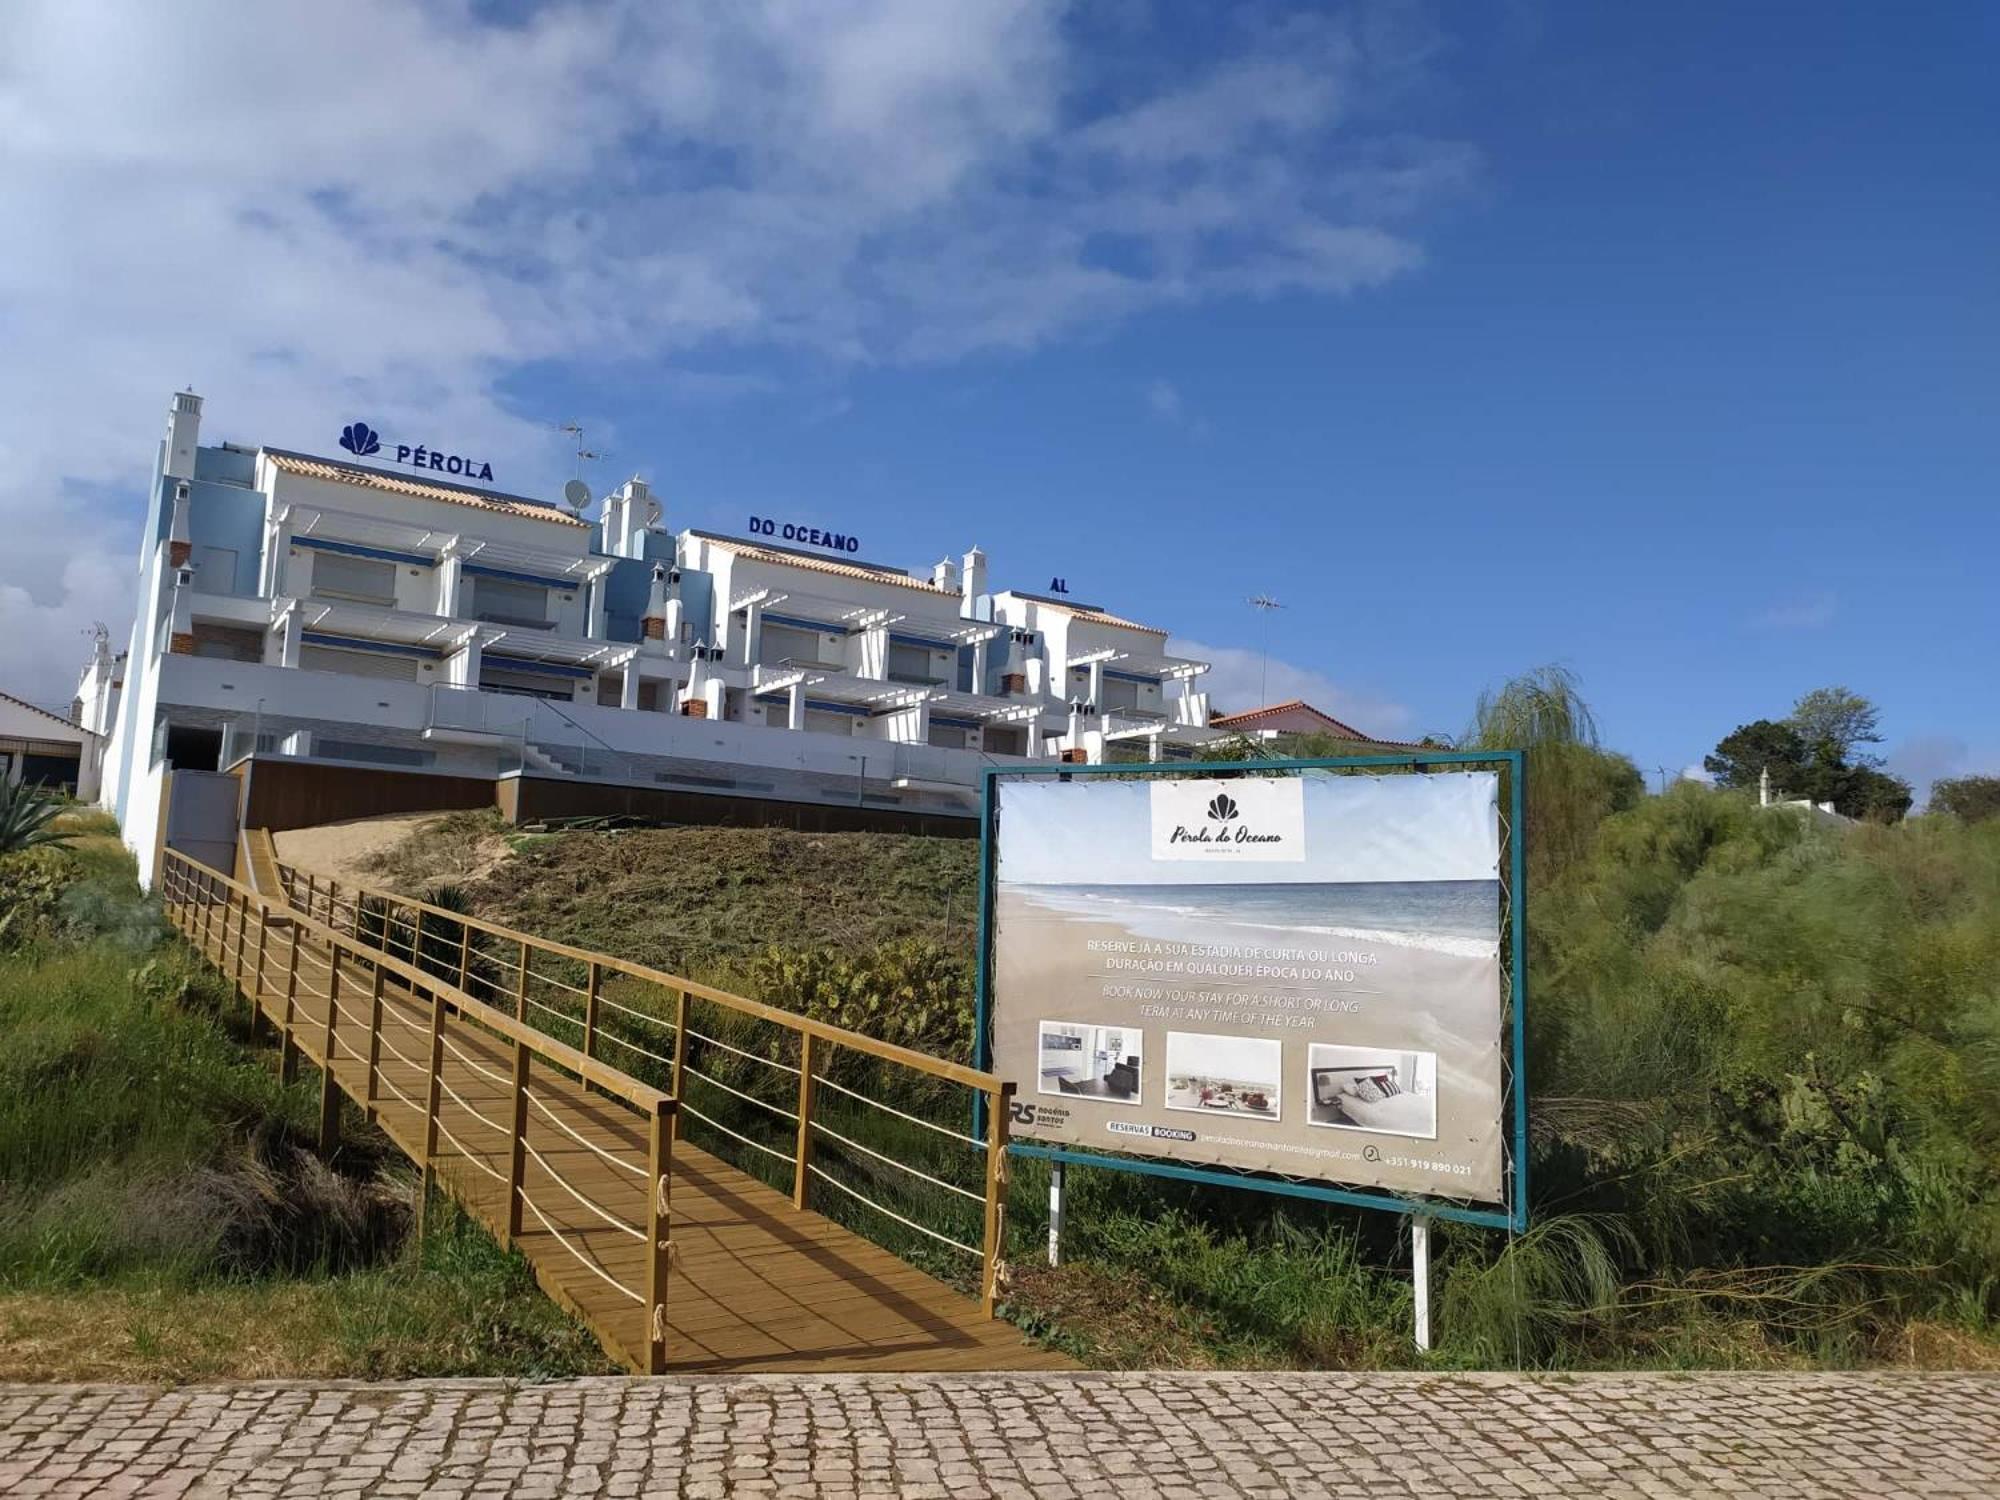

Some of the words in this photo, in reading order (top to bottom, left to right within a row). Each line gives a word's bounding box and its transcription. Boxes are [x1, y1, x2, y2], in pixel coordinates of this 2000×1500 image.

[396, 445, 493, 481] PÉROLA
[749, 516, 775, 535] DO
[783, 524, 859, 552] OCEANO
[1049, 577, 1069, 593] AL
[1170, 825, 1212, 844] Pérola
[1215, 826, 1231, 843] do
[1235, 825, 1282, 844] Oceano
[1087, 940, 1138, 953] RESERVE
[1138, 940, 1151, 954] JÁ
[1153, 943, 1162, 954] A
[1165, 943, 1187, 956] SUA
[1191, 945, 1241, 958] ESTADIA
[1244, 947, 1261, 959] DE
[1263, 948, 1305, 961] CURTA
[1308, 950, 1328, 962] OU
[1331, 951, 1377, 965] LONGA
[1106, 958, 1163, 972] DURAÇÃO
[1166, 961, 1184, 973] EM
[1186, 962, 1253, 977] QUALQUER
[1302, 968, 1321, 980] DO
[1324, 968, 1355, 982] ANO
[1103, 984, 1134, 999] BOOK
[1134, 987, 1165, 1000] NOW
[1166, 989, 1196, 1002] YOUR
[1199, 991, 1223, 1004] STAY
[1226, 993, 1249, 1006] FOR
[1260, 995, 1301, 1009] SHORT
[1303, 998, 1321, 1010] OR
[1323, 999, 1360, 1013] LONG
[1141, 1005, 1170, 1017] TERM
[1171, 1007, 1185, 1018] AT
[1186, 1008, 1211, 1020] ANY
[1213, 1010, 1240, 1022] TIME
[1240, 1012, 1255, 1025] OF
[1257, 1013, 1282, 1026] THE
[1285, 1015, 1316, 1028] YEAR
[1110, 1122, 1150, 1135] RESERVAS
[1153, 1128, 1193, 1141] BOOKING
[1386, 1157, 1408, 1168] +351
[1410, 1159, 1430, 1170] 919
[1431, 1161, 1451, 1173] 890
[1453, 1165, 1472, 1176] 021
